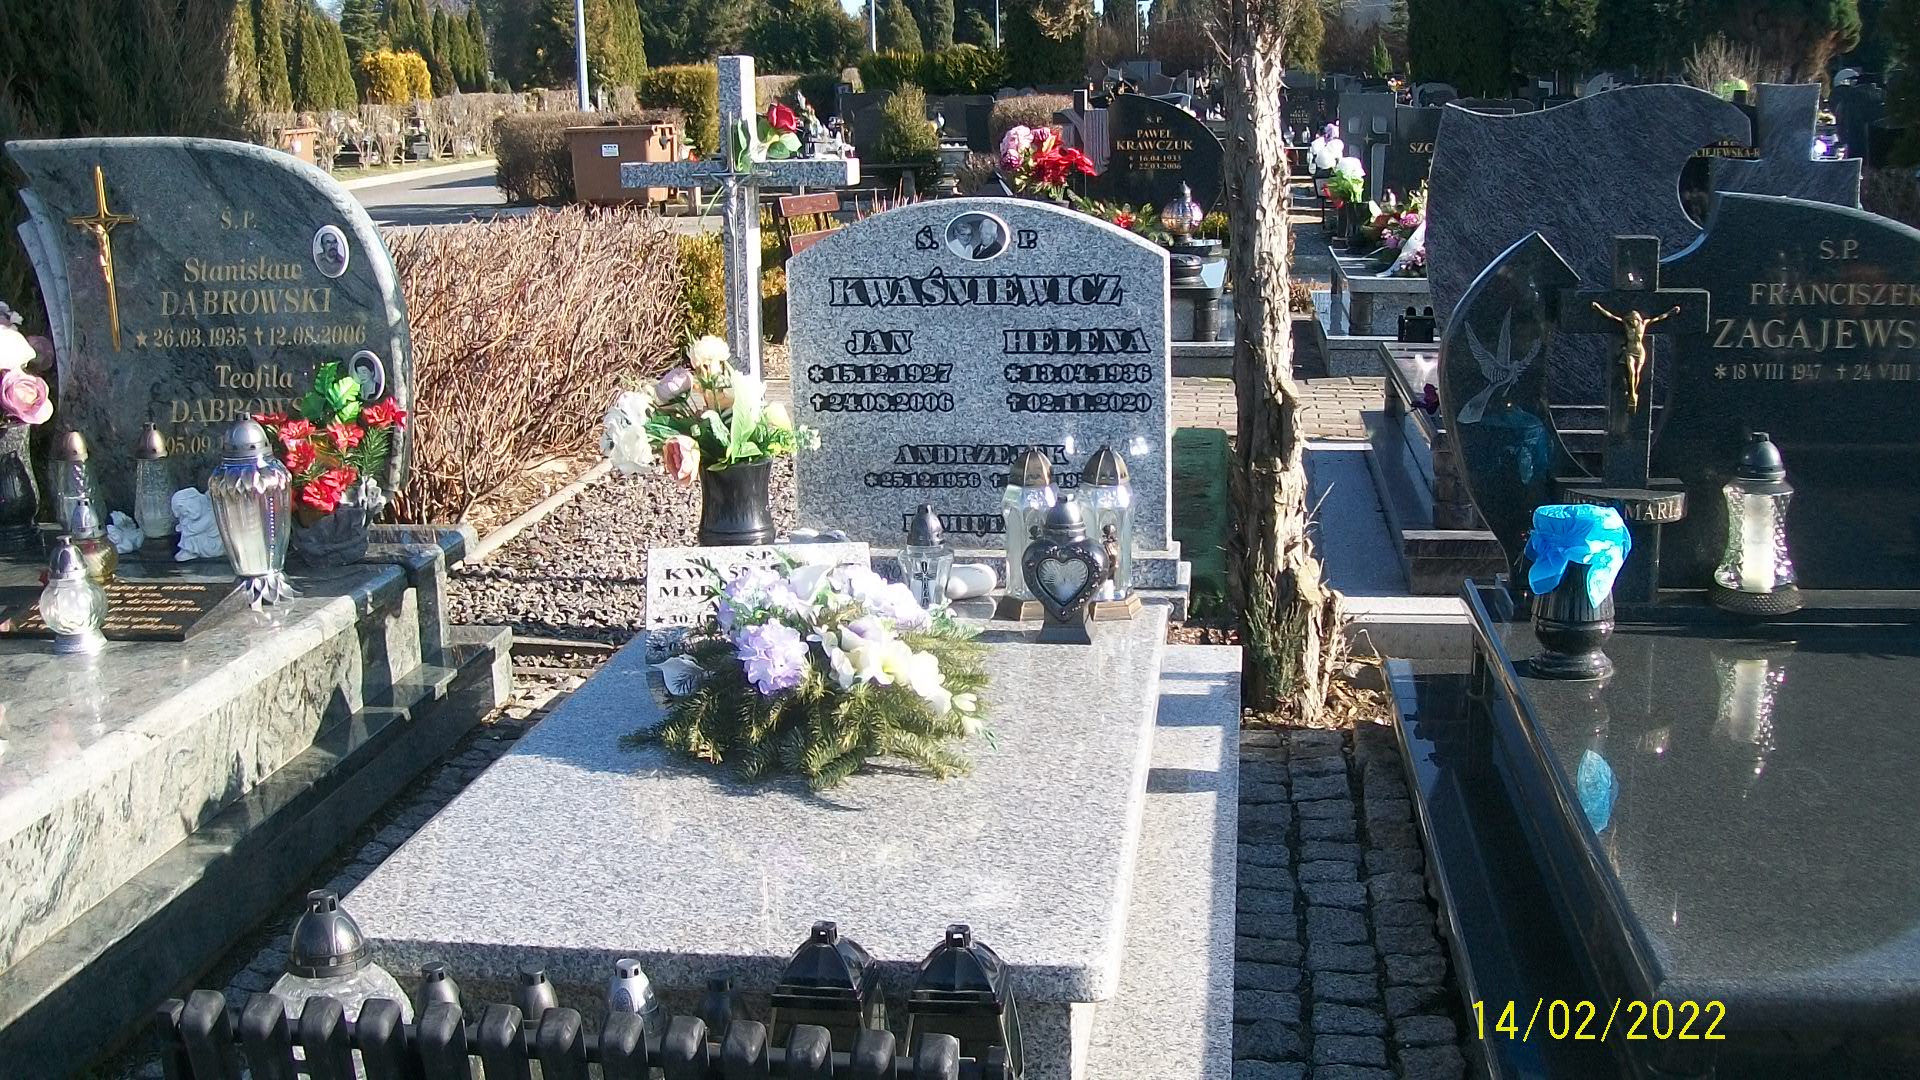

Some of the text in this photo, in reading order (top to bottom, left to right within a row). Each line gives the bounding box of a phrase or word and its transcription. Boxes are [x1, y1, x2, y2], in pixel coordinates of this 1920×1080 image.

[1116, 140, 1193, 150] KRAWCZUK
[184, 256, 303, 283] Stanisław
[829, 267, 1124, 306] KWAŚNIEWICZ
[160, 287, 332, 320] DĄBROWSKI
[153, 325, 366, 348] 26.03.1935 12.08.2006
[845, 330, 914, 355] JAN
[1003, 329, 1151, 354] HELENA
[215, 363, 293, 392] Teofila
[830, 362, 953, 383] 15.12.1927
[1028, 363, 1152, 383] 13.04.1936
[1732, 364, 1747, 380] 18
[1752, 364, 1784, 380] VIII
[1853, 364, 1872, 380] 24
[828, 393, 954, 412] 24.08.2006
[1027, 393, 1152, 412] 02.11.2020
[881, 472, 980, 488] 25.12.1956
